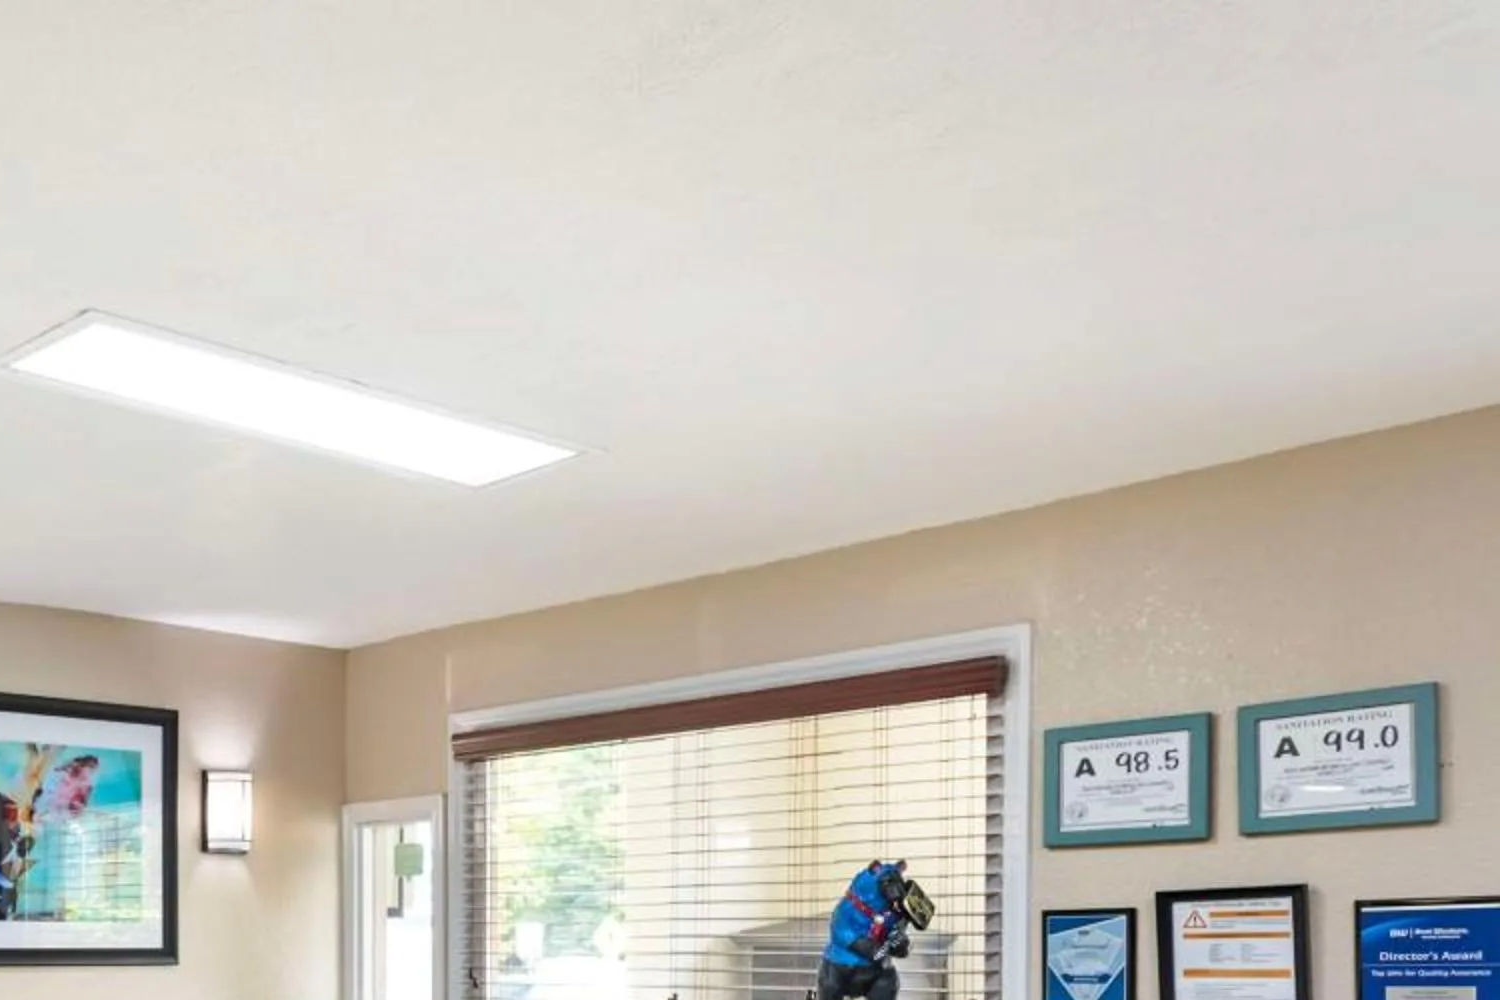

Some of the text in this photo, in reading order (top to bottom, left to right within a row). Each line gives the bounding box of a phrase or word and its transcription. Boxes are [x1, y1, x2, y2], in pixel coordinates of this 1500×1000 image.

[1274, 736, 1300, 758] A
[1075, 757, 1096, 778] A
[1380, 951, 1482, 961] Director's Award
